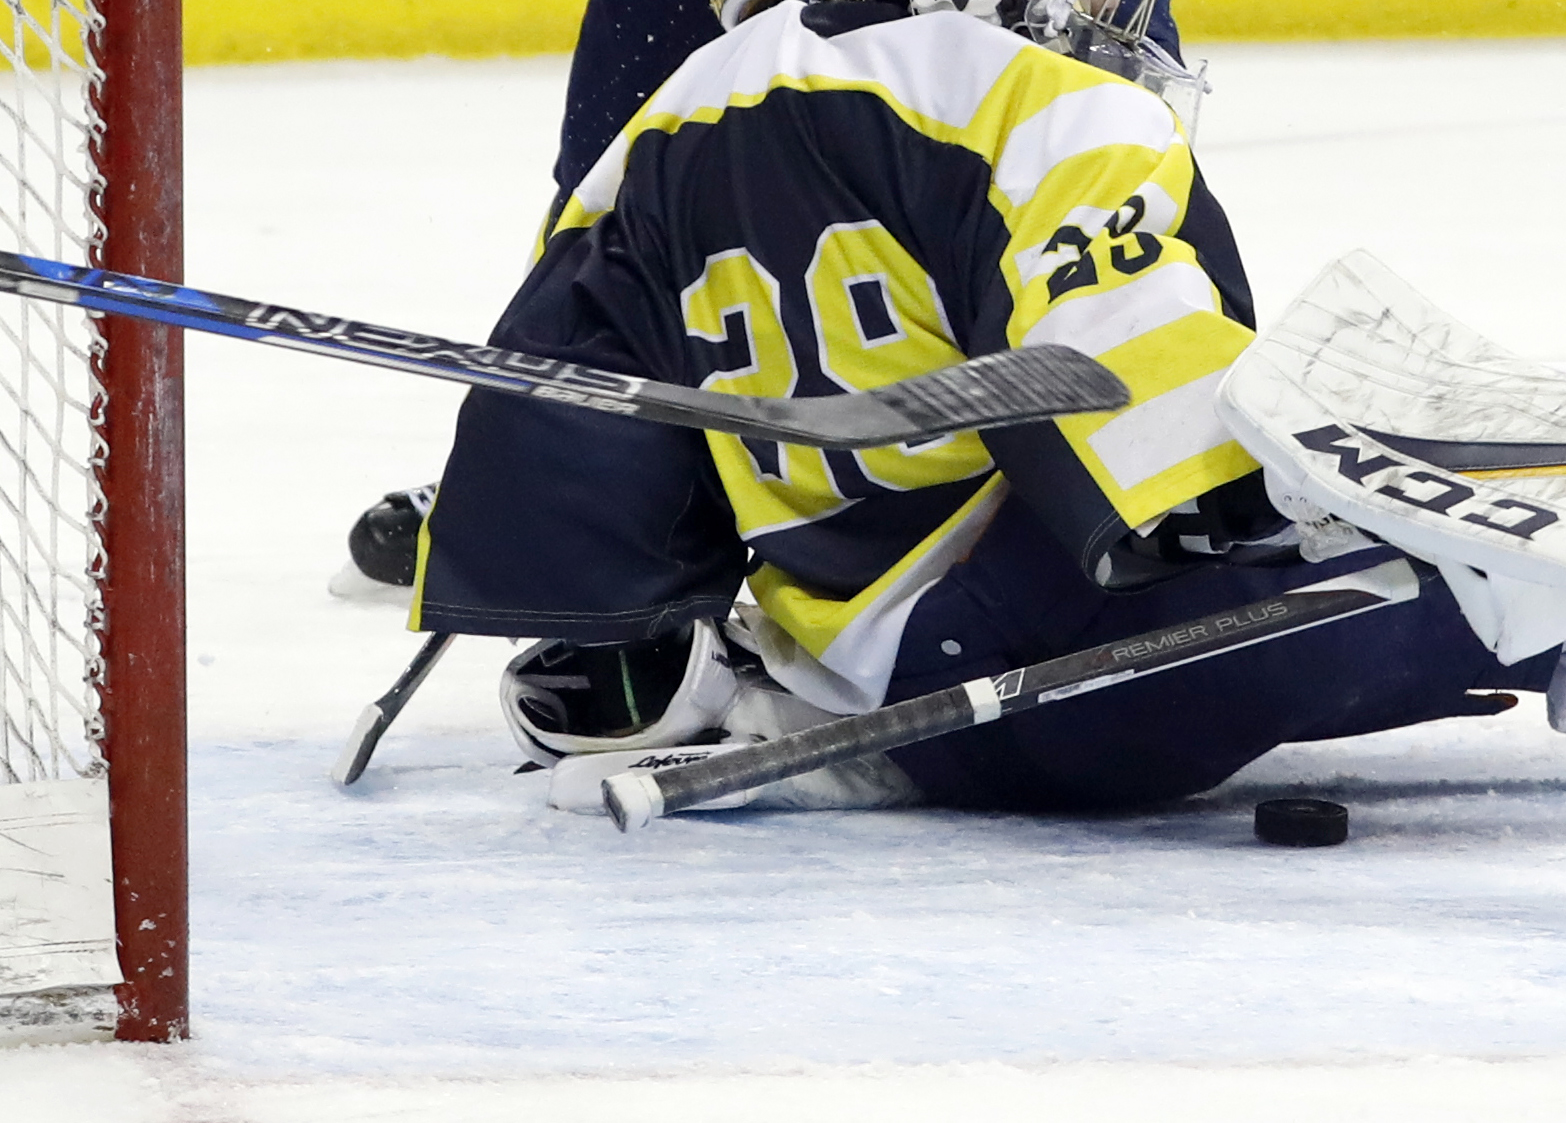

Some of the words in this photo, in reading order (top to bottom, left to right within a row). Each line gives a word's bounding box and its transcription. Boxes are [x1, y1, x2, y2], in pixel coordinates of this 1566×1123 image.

[1291, 423, 1561, 541] CCM
[1108, 624, 1209, 662] REMIER
[1215, 601, 1289, 633] PLUS
